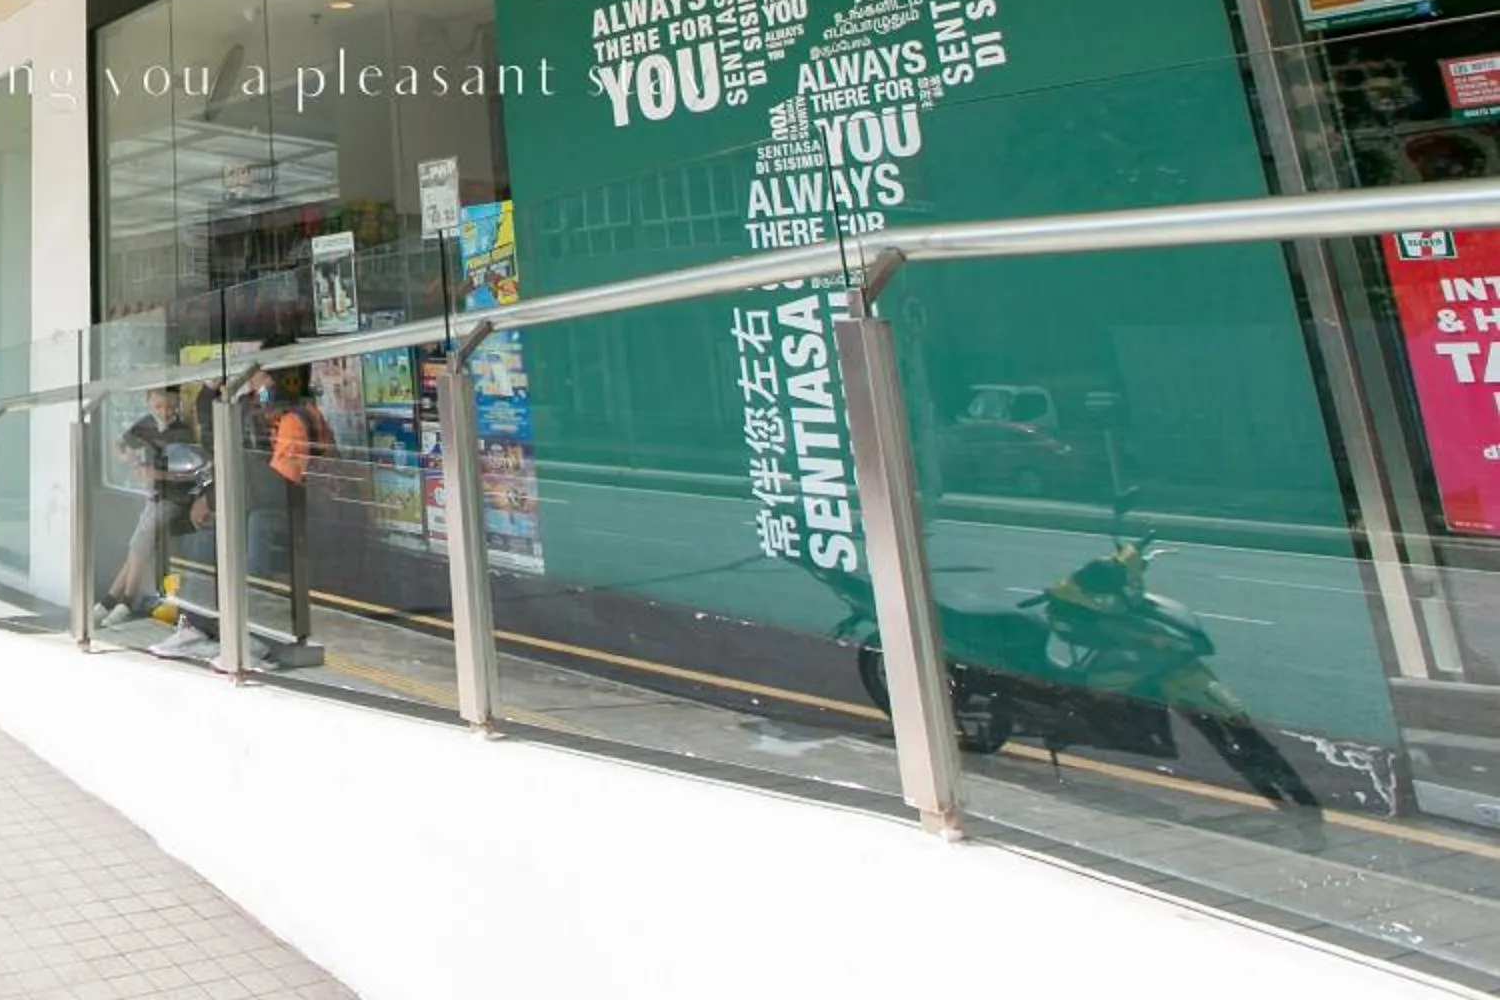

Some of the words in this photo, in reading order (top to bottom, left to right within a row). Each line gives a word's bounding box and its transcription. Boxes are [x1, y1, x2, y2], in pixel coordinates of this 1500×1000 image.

[593, 27, 662, 63] THERE
[668, 14, 714, 46] FOR
[972, 31, 1007, 68] DI
[597, 41, 721, 128] YOU
[746, 59, 768, 87] DI
[797, 40, 928, 95] ALWAYS
[810, 85, 871, 113] THERE
[874, 78, 915, 102] FOR
[769, 102, 789, 141] YOU
[814, 103, 922, 166] YOU
[755, 160, 770, 175] DI
[773, 153, 823, 172] SISIMU
[757, 139, 822, 160] SENTIASA
[748, 163, 905, 219] ALWAYS
[745, 217, 826, 249] THERE
[731, 307, 801, 558] 常伴您左右
[776, 294, 858, 573] SENTIASA
